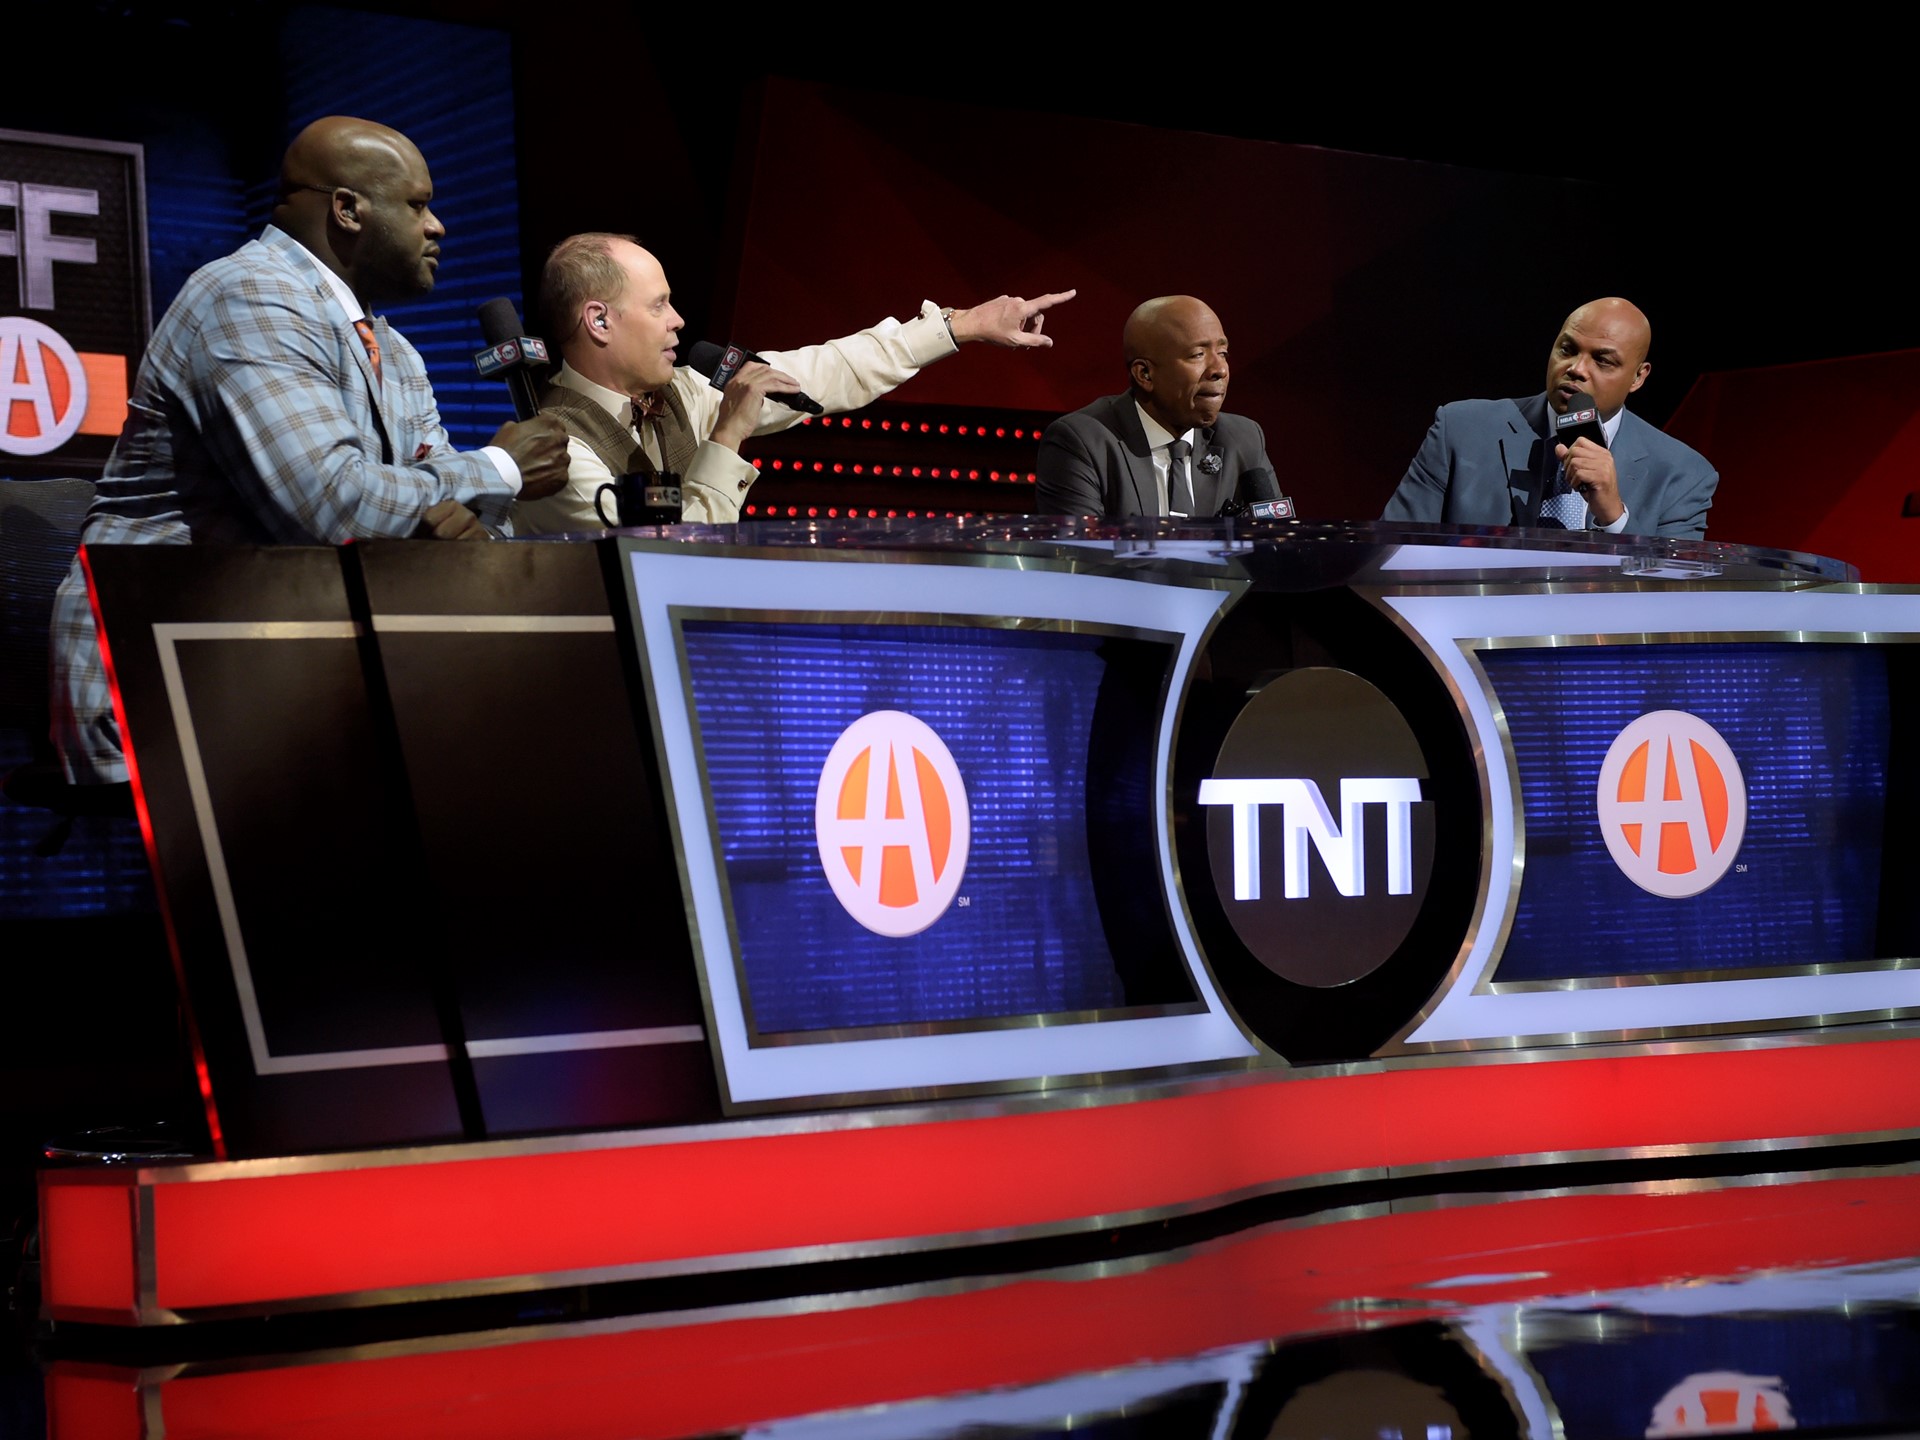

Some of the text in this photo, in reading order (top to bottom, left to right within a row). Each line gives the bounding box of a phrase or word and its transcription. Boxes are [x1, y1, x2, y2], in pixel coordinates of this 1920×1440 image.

[480, 354, 496, 368] NBA
[716, 371, 728, 385] NBA
[1559, 416, 1573, 424] NBA
[1256, 508, 1270, 518] NBA
[1198, 777, 1422, 901] TNT
[1735, 864, 1748, 873] SM
[958, 896, 970, 907] SM
